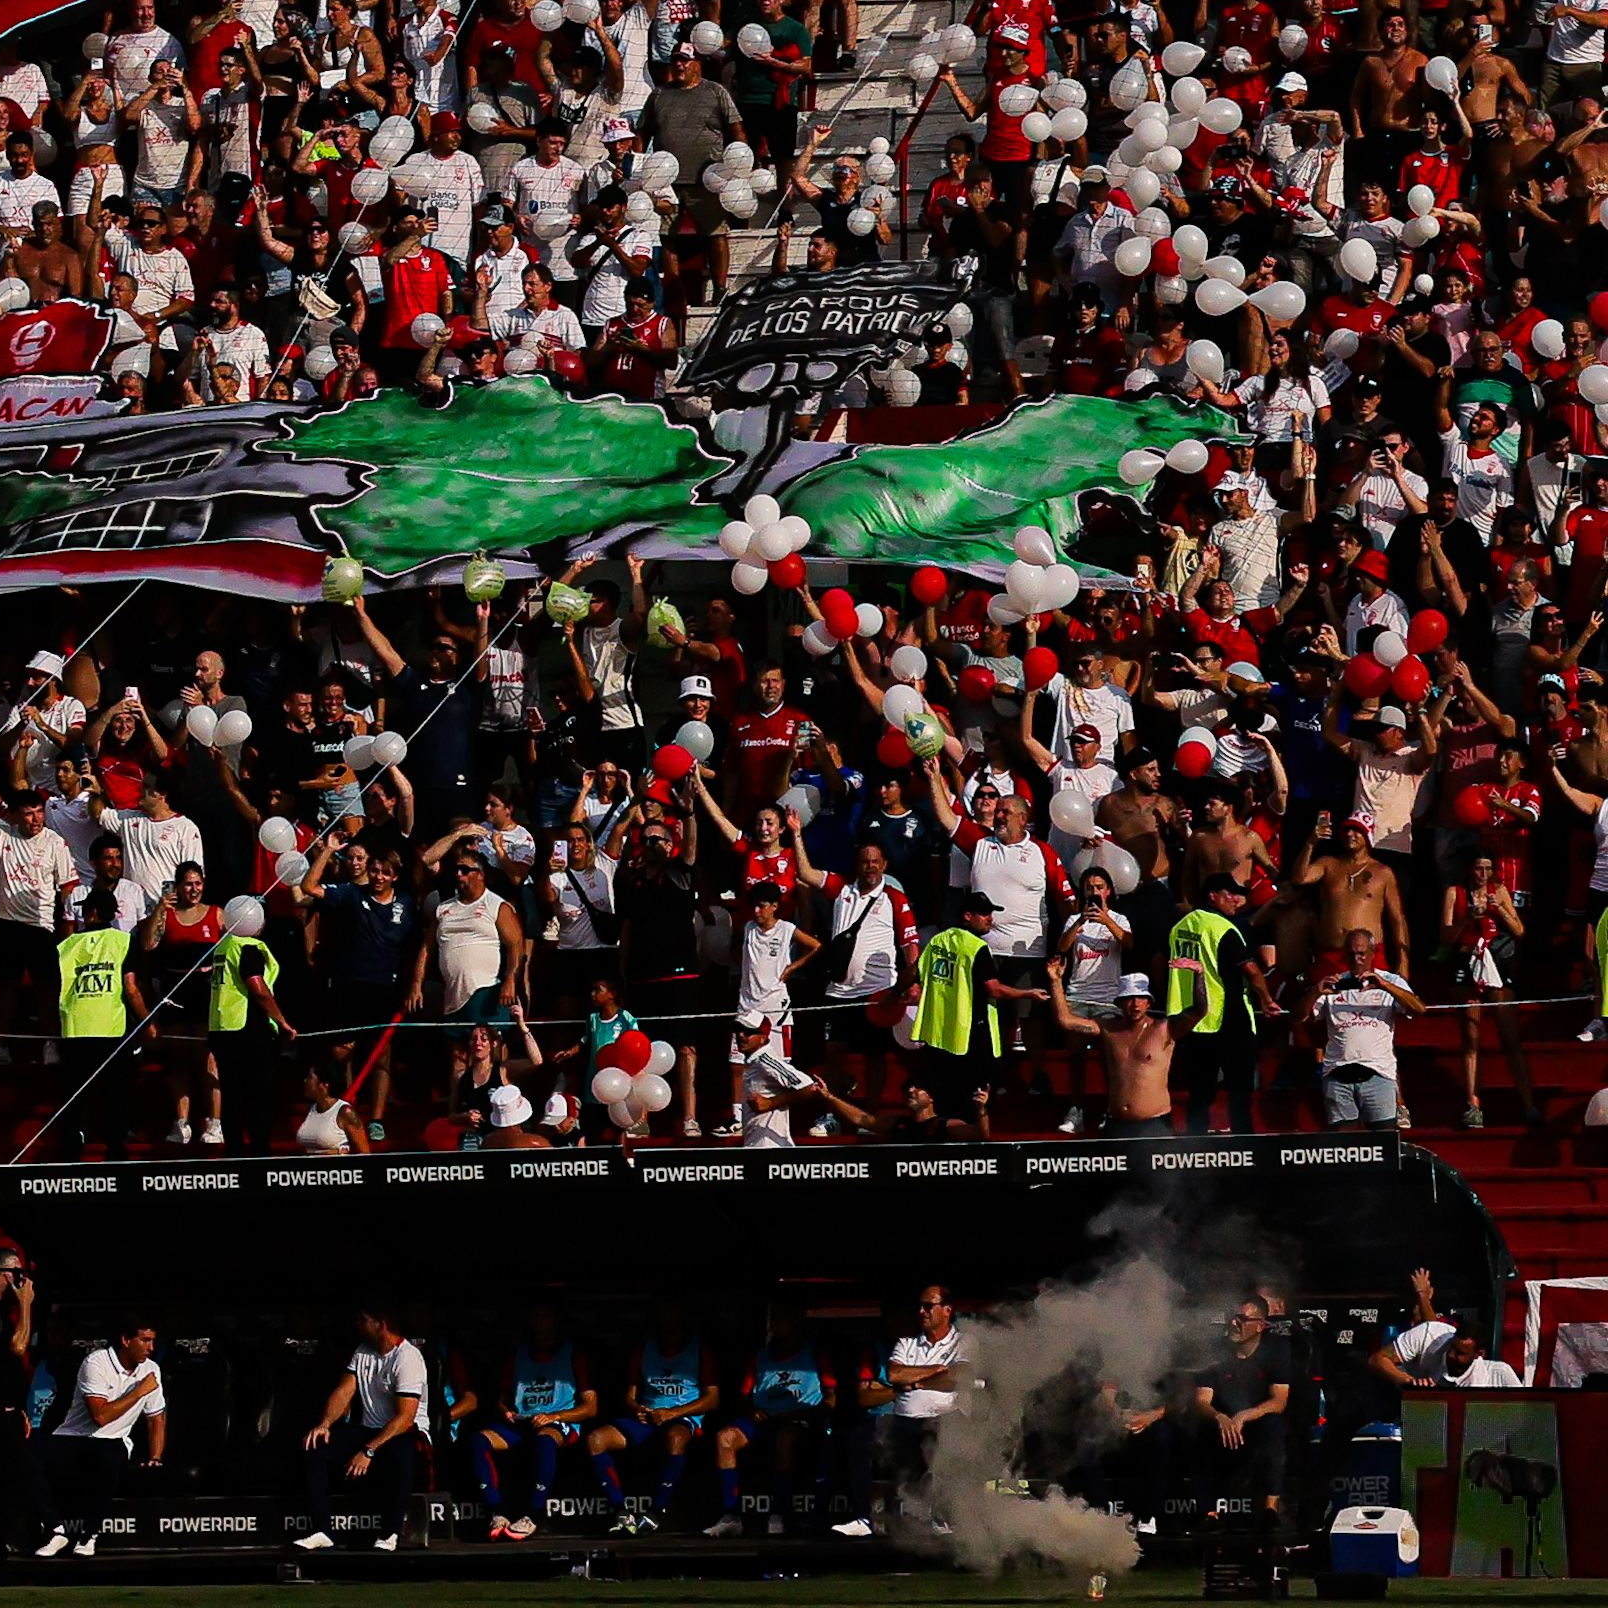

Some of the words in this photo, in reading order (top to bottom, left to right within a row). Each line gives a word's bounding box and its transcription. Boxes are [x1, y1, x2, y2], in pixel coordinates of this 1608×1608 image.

[540, 201, 569, 210] Banco
[763, 292, 919, 311] PARQUE
[727, 324, 759, 349] DE
[761, 314, 810, 340] LOS
[20, 1176, 117, 1195] POWERADE
[142, 1172, 239, 1192] POWERADE
[266, 1168, 364, 1188] POWERADE
[386, 1164, 485, 1184] POWERADE
[510, 1159, 609, 1179] POWERADE
[643, 1162, 744, 1183] POWERADE
[768, 1160, 869, 1180] POWERADE
[896, 1158, 997, 1177] POWERADE
[1026, 1154, 1127, 1174] POWERADE
[1150, 1150, 1254, 1171] POWERADE
[1280, 1146, 1383, 1166] POWERADE
[158, 1515, 257, 1533] POWERADE
